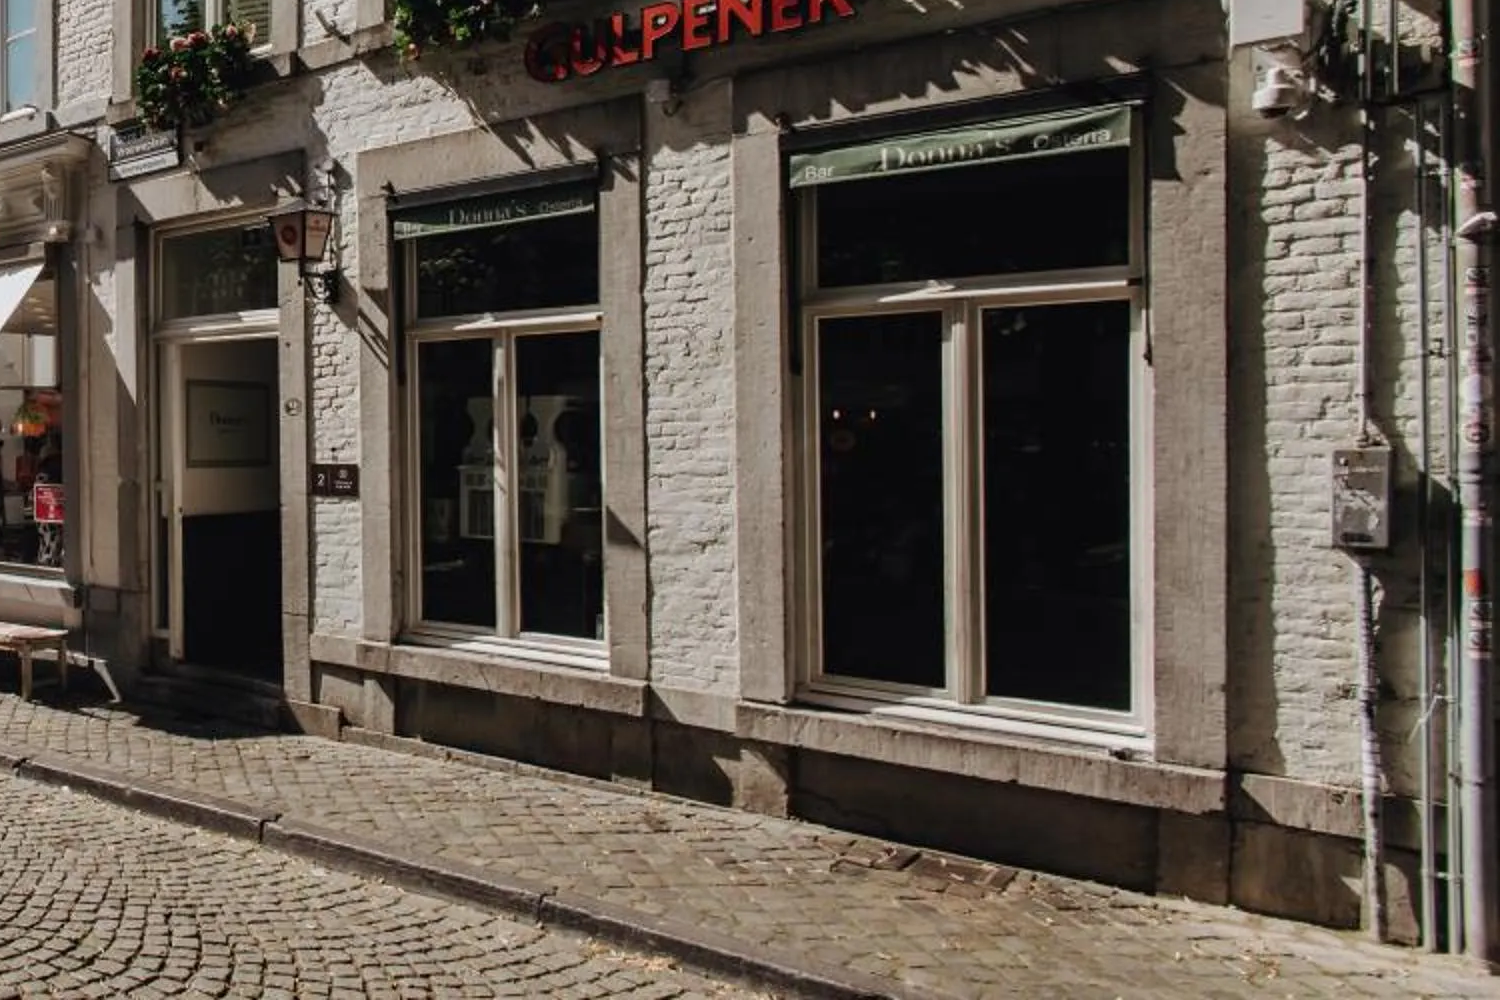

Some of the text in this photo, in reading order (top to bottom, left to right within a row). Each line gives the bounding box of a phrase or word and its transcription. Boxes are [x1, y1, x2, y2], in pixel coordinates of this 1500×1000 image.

[804, 164, 834, 180] Bar
[881, 130, 1011, 172] Donna's
[317, 473, 325, 486] 2
